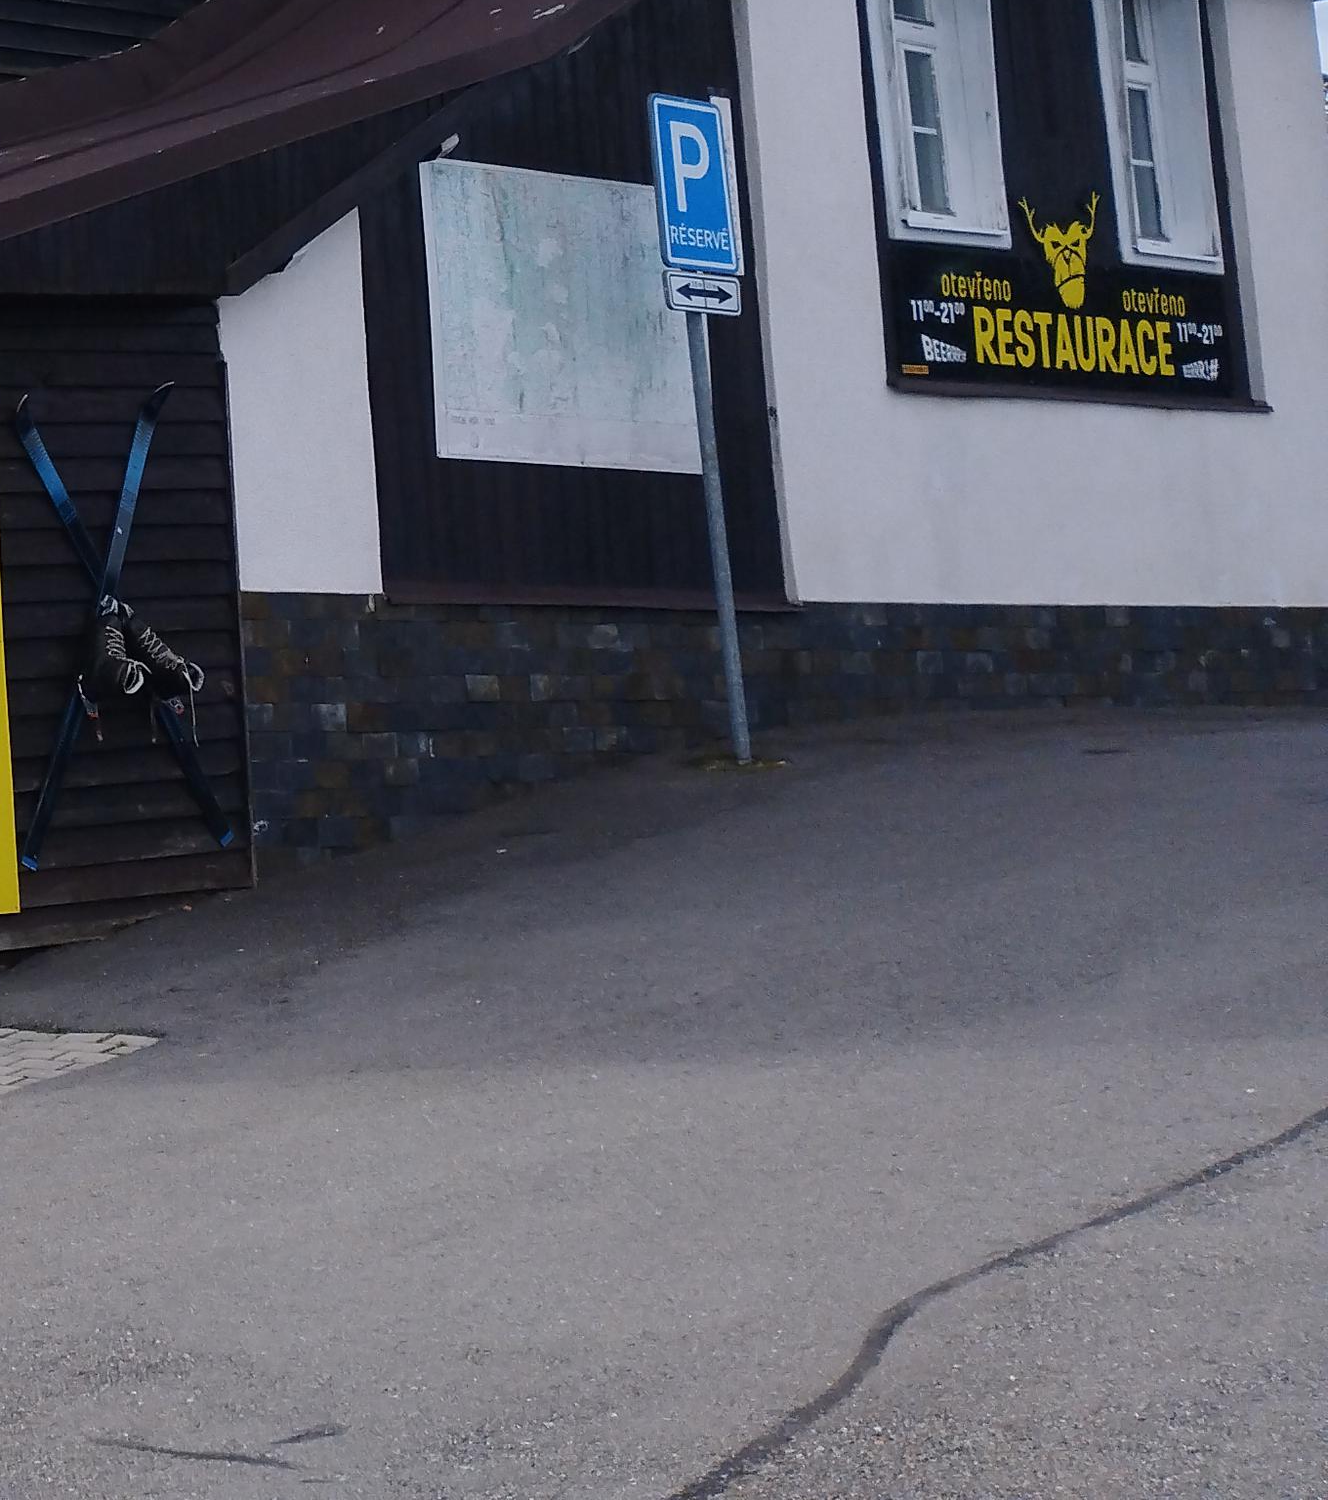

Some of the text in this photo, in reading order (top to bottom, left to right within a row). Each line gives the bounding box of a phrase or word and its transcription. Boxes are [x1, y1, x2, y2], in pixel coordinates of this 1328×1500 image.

[669, 120, 709, 213] P
[941, 270, 1012, 302] otevřeno
[1122, 286, 1186, 317] otevřeno
[972, 305, 1177, 377] RESTAURACE
